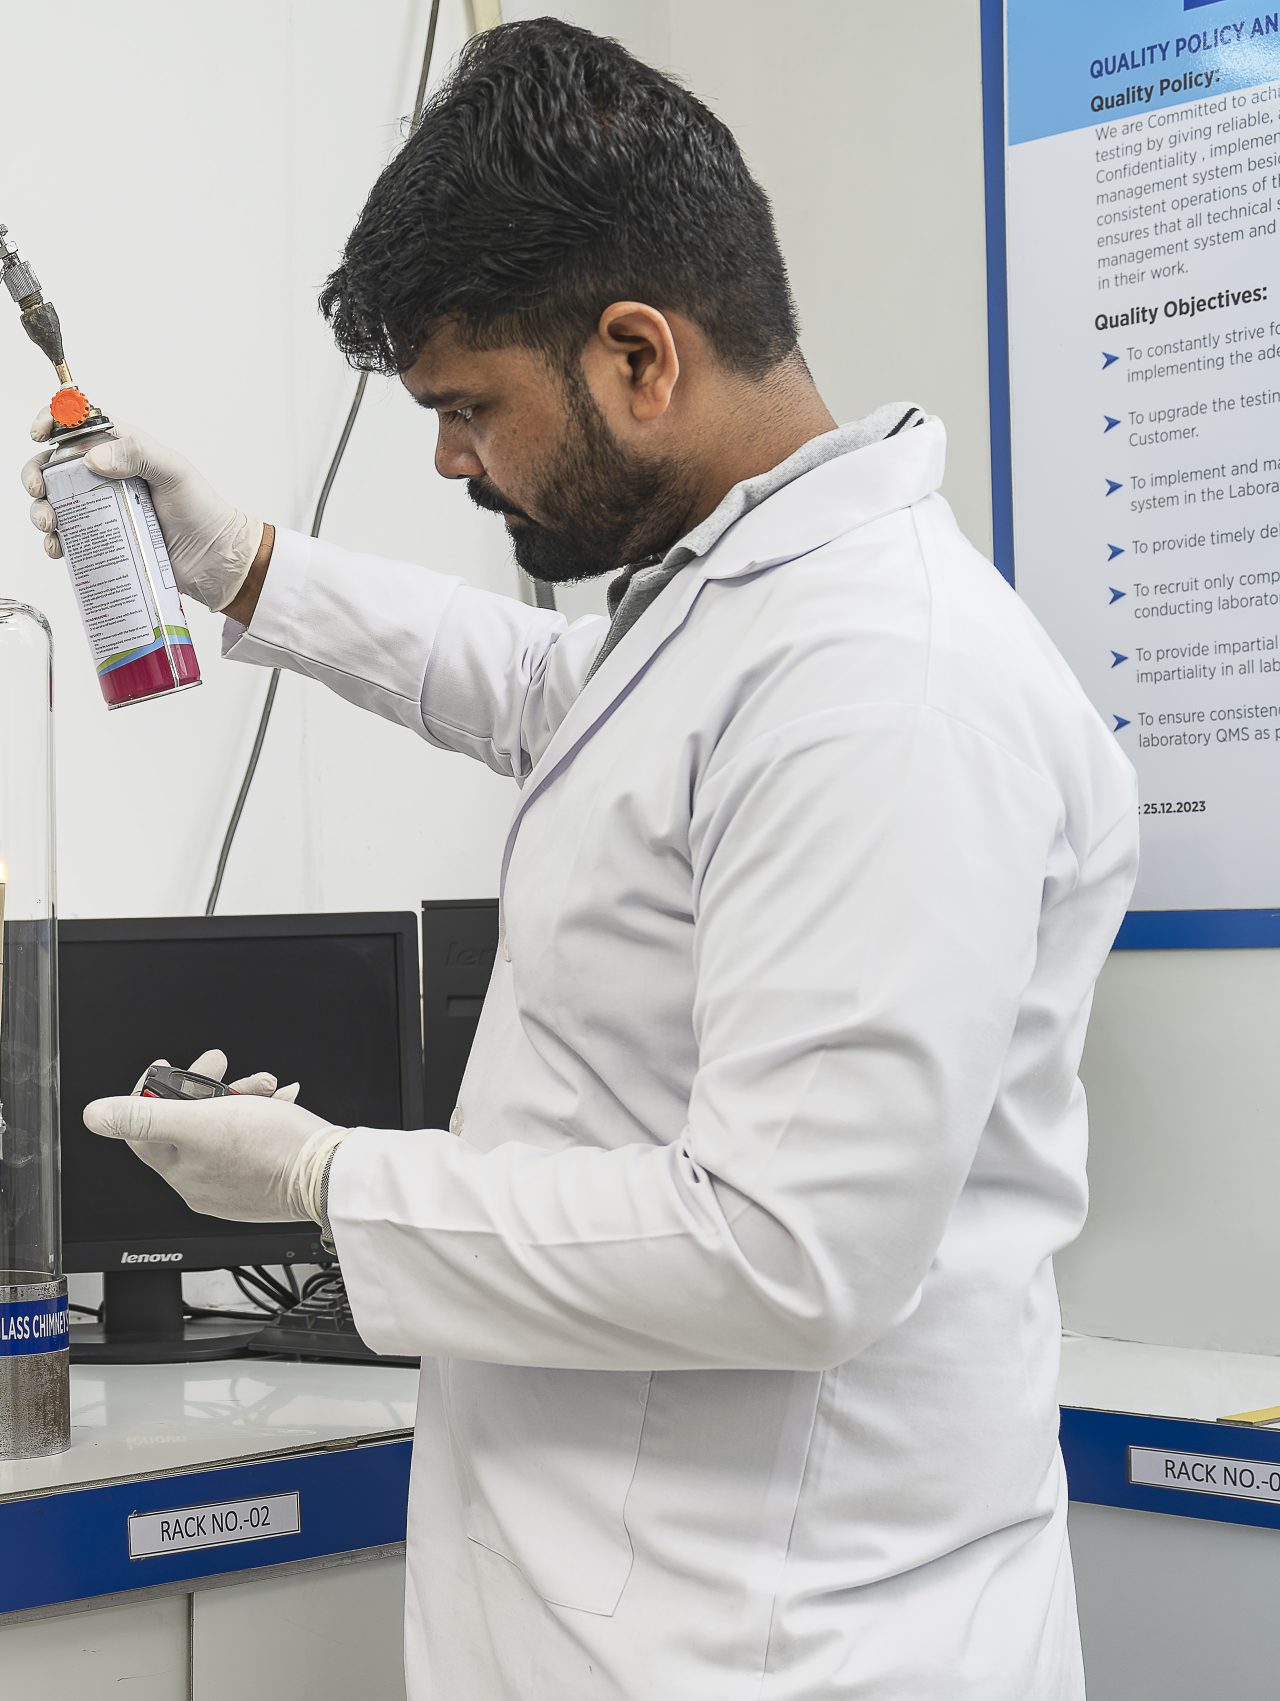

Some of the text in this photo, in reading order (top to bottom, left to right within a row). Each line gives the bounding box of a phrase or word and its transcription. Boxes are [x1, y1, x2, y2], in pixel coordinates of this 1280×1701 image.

[1090, 42, 1169, 79] QUALITY
[1176, 21, 1245, 57] POLICY
[1091, 67, 1221, 112] Quality Policy:
[1096, 127, 1117, 141] We
[1123, 120, 1143, 135] are
[1148, 98, 1227, 128] Committed
[1232, 95, 1246, 107] to
[1096, 111, 1273, 162] testing by giving reliable,
[1096, 151, 1197, 184] Confidentiality
[1096, 175, 1188, 205] management
[1193, 164, 1242, 184] system
[1096, 200, 1166, 226] consistent
[1172, 185, 1247, 214] operations
[1252, 176, 1266, 193] of
[1097, 226, 1149, 247] ensures
[1155, 220, 1181, 236] that
[1187, 213, 1201, 229] all
[1207, 198, 1272, 224] technical
[1098, 220, 1276, 269] management system and
[1098, 261, 1188, 290] in their work.
[1095, 287, 1267, 330] Quality Objectives:
[1127, 347, 1142, 361] To
[1147, 334, 1220, 357] constantly
[1225, 323, 1264, 344] strive
[1127, 355, 1224, 383] implementing
[1229, 350, 1252, 366] the
[1129, 411, 1144, 424] To
[1149, 402, 1207, 423] upgrade
[1212, 397, 1235, 412] the
[1129, 426, 1199, 447] Customer.
[1130, 476, 1145, 489] To
[1151, 464, 1226, 487] implement
[1231, 459, 1257, 476] and
[1130, 494, 1179, 513] system
[1184, 490, 1196, 504] in
[1201, 487, 1224, 502] the
[1132, 541, 1148, 554] To
[1153, 531, 1205, 554] provide
[1211, 527, 1255, 545] timely
[1134, 583, 1149, 597] To
[1154, 578, 1199, 594] recruit
[1205, 574, 1234, 593] only
[1134, 592, 1280, 619] conducting laborato
[1136, 635, 1278, 664] To provide impartial
[1137, 664, 1216, 685] impartiality
[1222, 662, 1234, 676] in
[1238, 660, 1254, 674] all
[1138, 703, 1280, 725] To ensure consisten
[1139, 728, 1211, 747] laboratory
[1216, 726, 1249, 743] QMS
[1255, 728, 1270, 740] as
[1143, 800, 1206, 815] 25.12.2023
[120, 1250, 184, 1264] lenovo
[1165, 1459, 1217, 1484] RACK
[160, 1505, 271, 1542] RACK NO.-02
